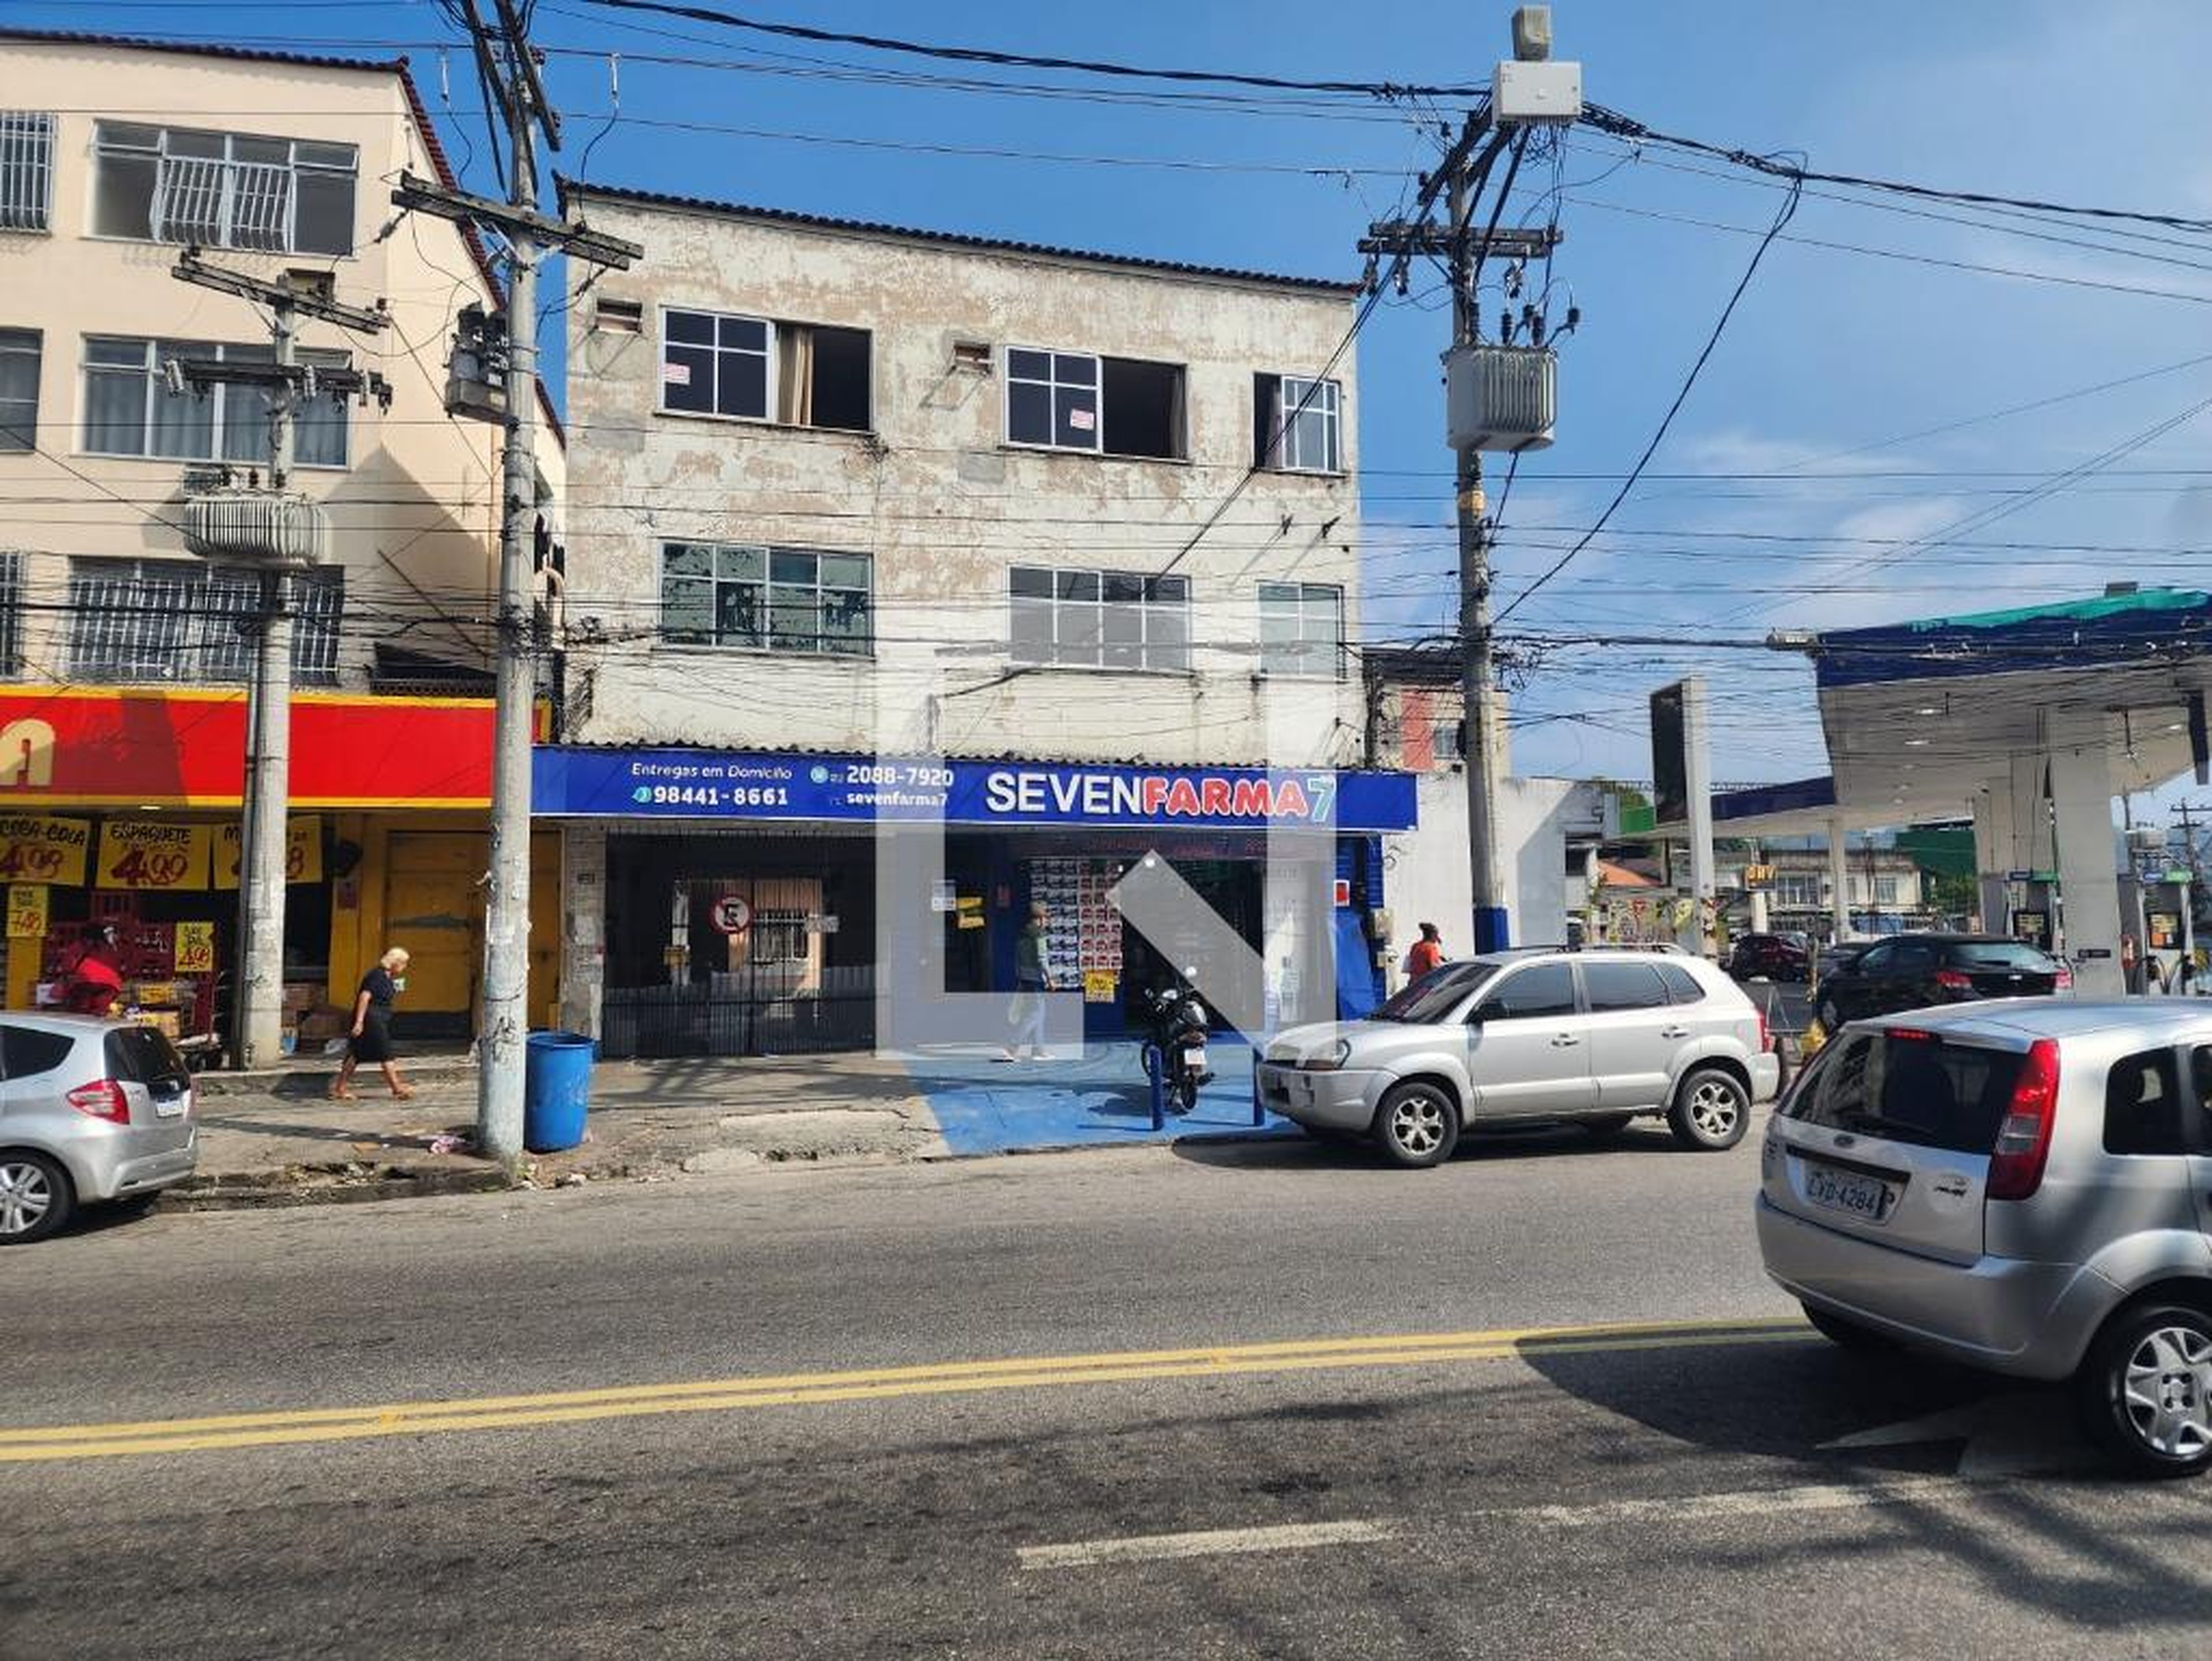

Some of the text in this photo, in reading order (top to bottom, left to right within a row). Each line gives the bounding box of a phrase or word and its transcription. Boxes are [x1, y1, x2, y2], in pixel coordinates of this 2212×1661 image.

[631, 762, 698, 779] Entregas
[702, 766, 724, 777] em
[846, 765, 955, 786] 2088-7920
[653, 786, 788, 805] 98441-8661
[846, 790, 948, 807] sevenfarma7
